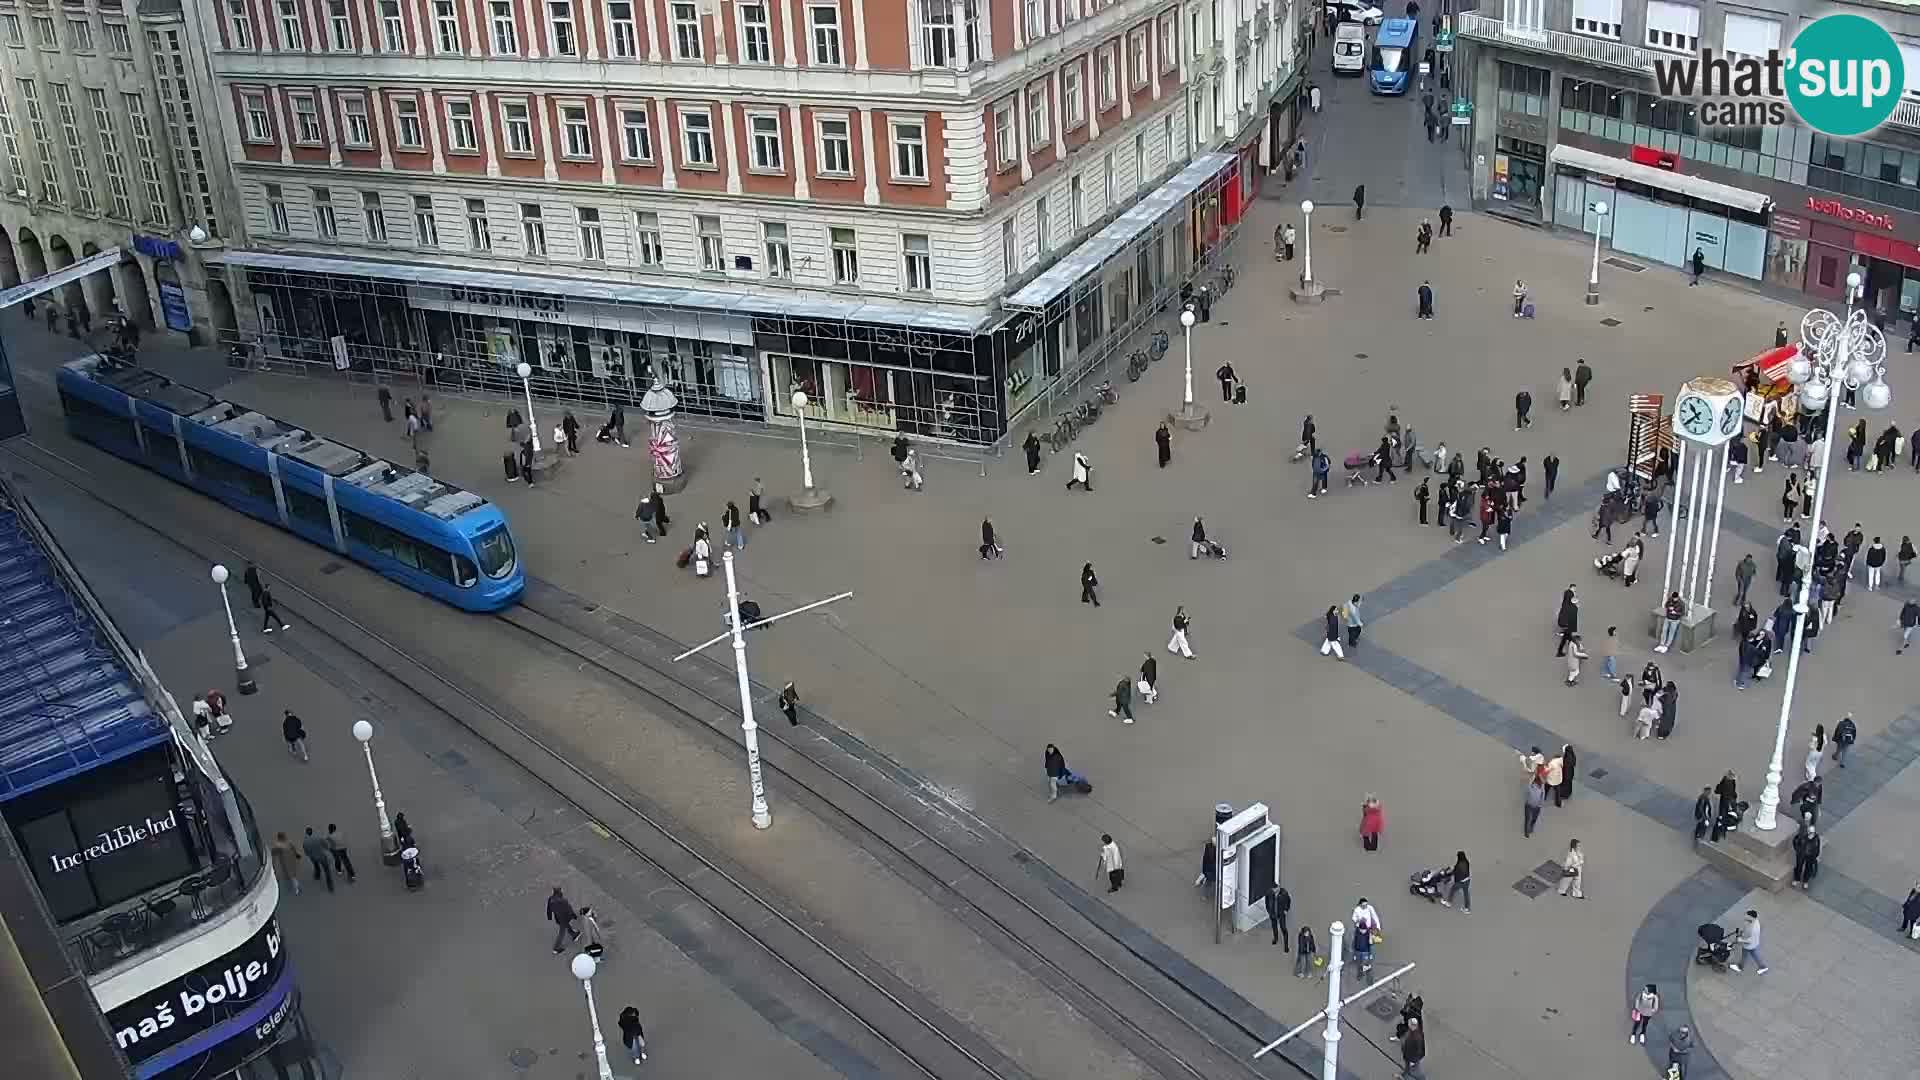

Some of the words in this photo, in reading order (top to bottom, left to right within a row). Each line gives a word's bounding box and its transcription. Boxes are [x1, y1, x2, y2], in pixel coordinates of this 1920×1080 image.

[1855, 208, 1895, 230] Bank
[50, 825, 147, 872] Incredible
[115, 1000, 176, 1049] naš
[180, 960, 268, 1017] bolje,
